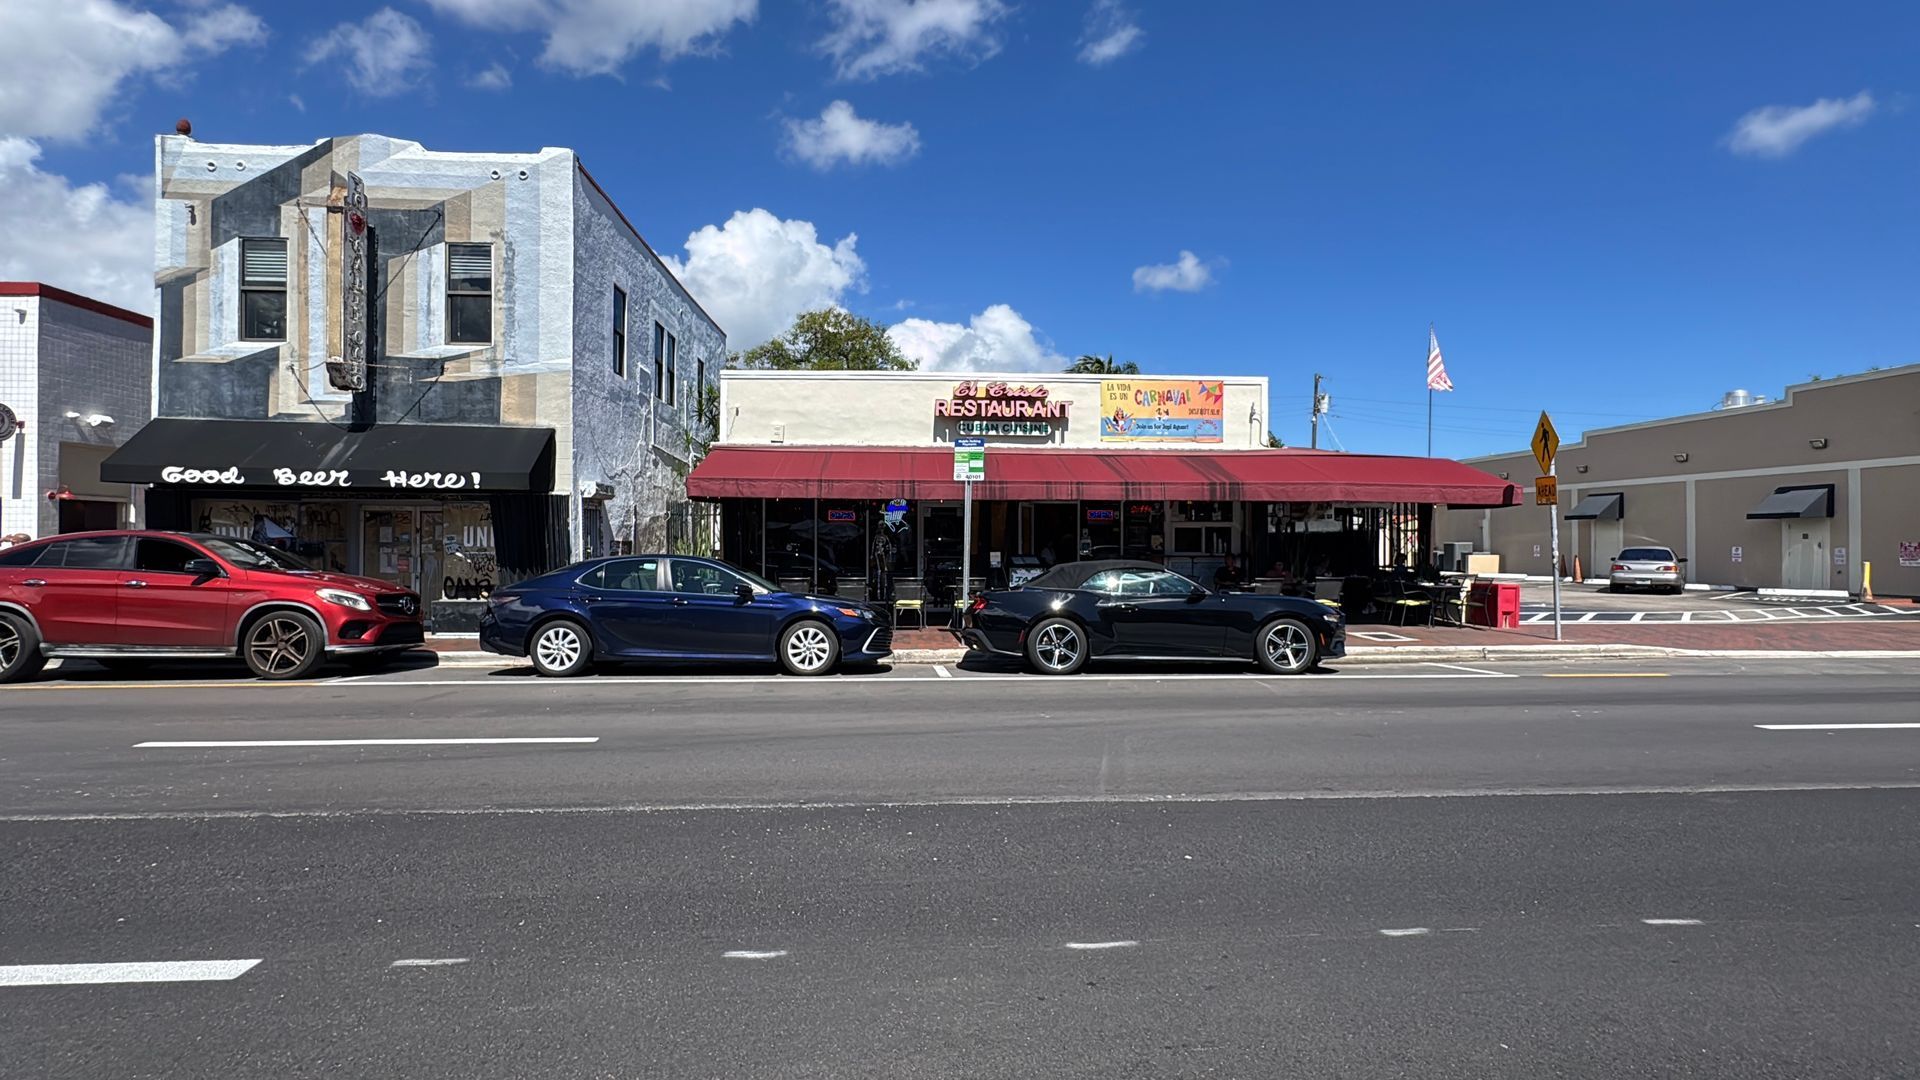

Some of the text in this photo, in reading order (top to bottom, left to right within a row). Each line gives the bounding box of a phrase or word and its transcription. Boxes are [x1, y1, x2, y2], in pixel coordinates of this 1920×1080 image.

[954, 380, 978, 397] El
[1106, 384, 1131, 392] LA VIDA
[1109, 392, 1128, 401] ES UN
[1134, 388, 1191, 407] CARNAVAL
[935, 399, 1074, 418] RESTAURANT
[958, 422, 1049, 435] CUBAN CUISINE
[161, 466, 481, 489] Good Beer Here!
[1537, 484, 1556, 497] AHEAD
